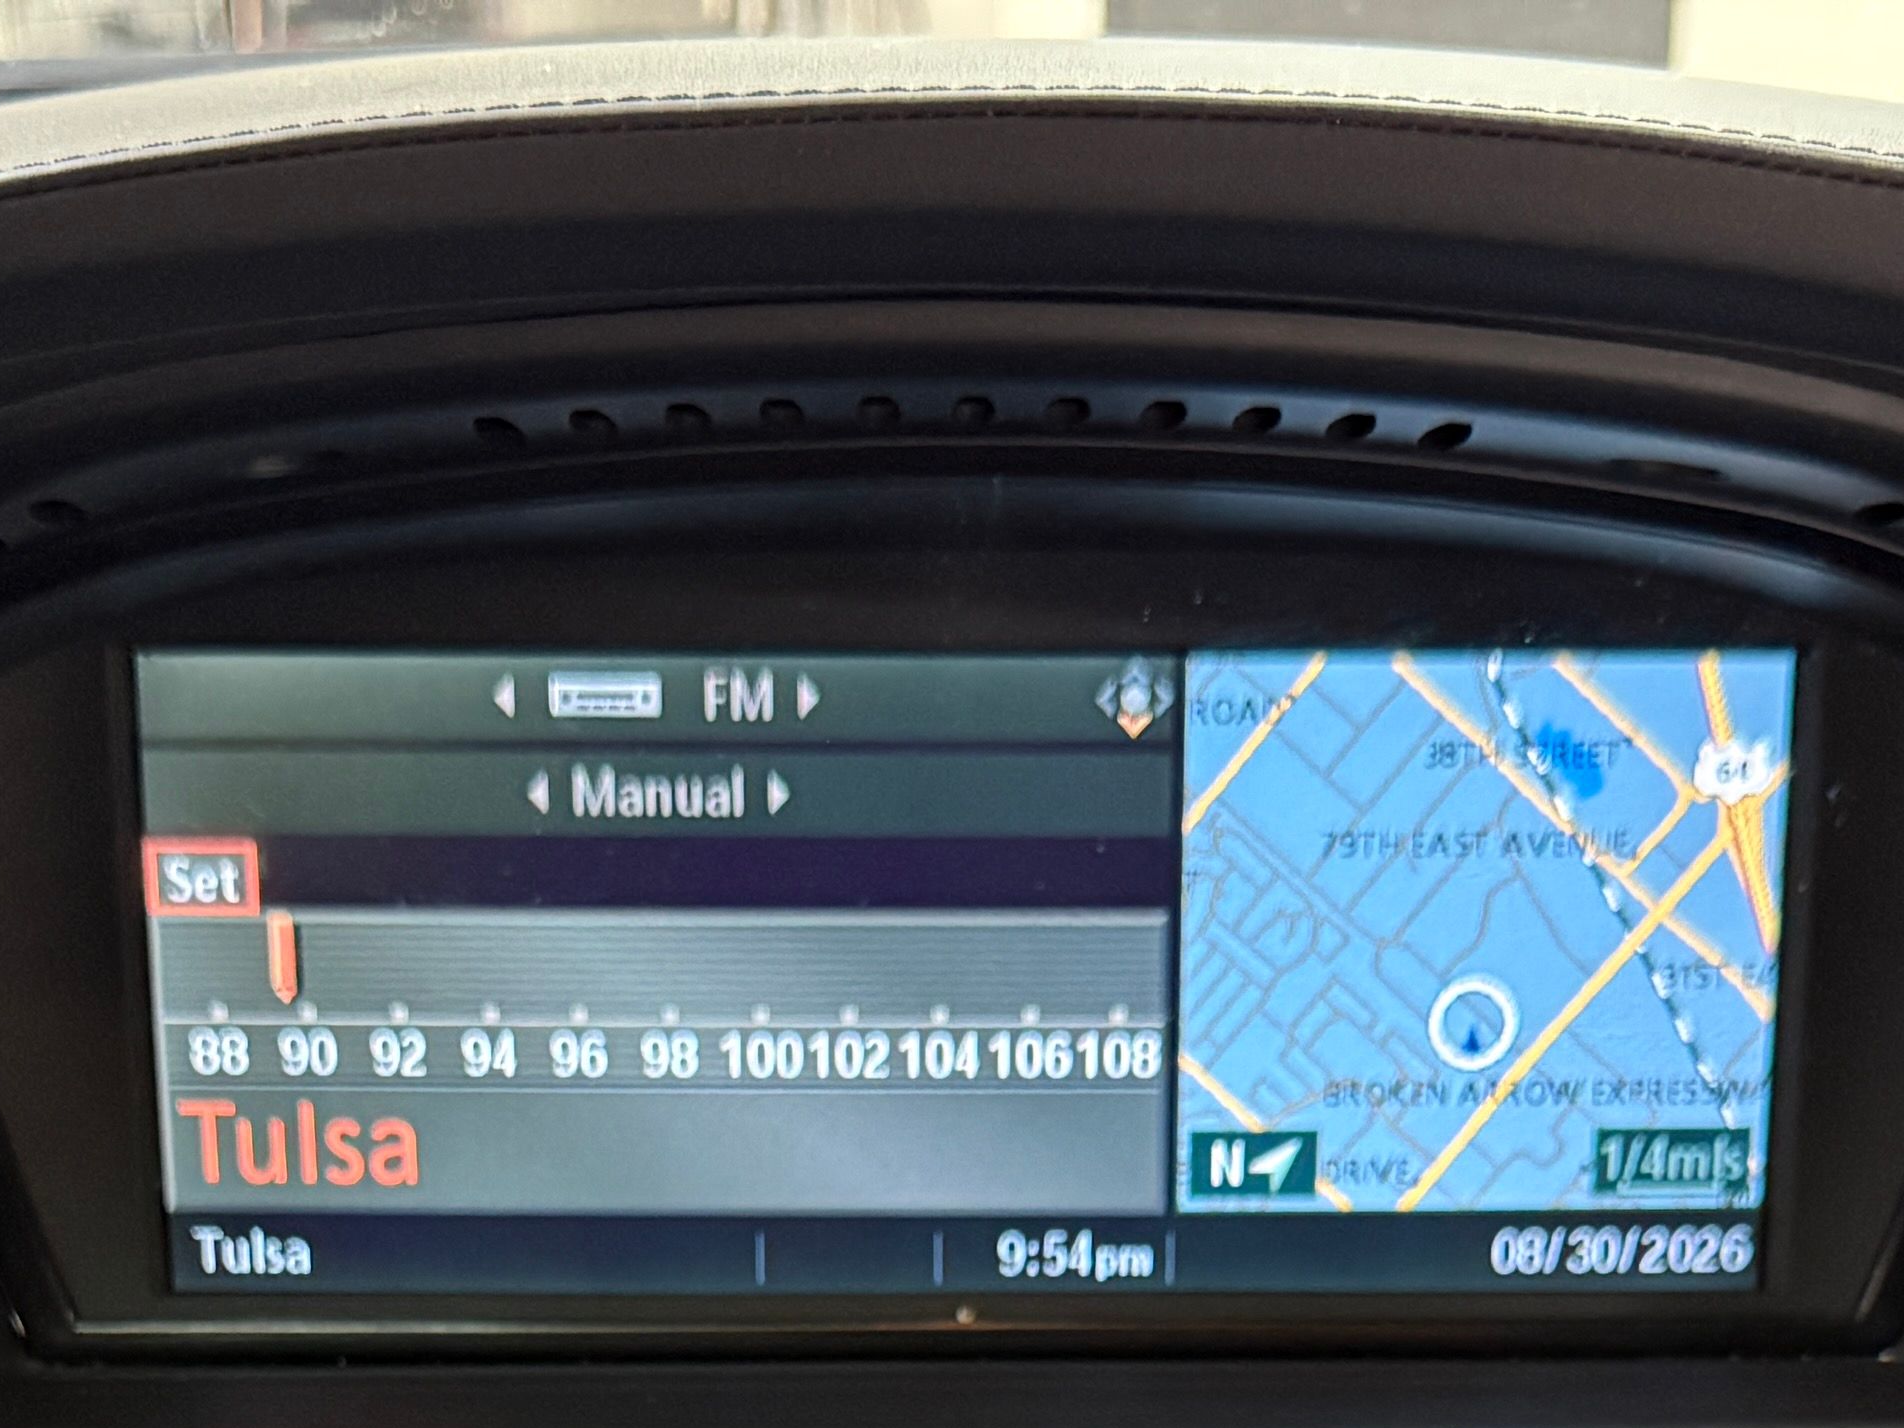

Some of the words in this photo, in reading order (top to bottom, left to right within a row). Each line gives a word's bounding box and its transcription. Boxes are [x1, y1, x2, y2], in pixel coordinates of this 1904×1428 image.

[704, 667, 774, 722] FM
[1190, 697, 1278, 727] ROA
[571, 763, 745, 818] Manual
[1411, 830, 1490, 859] EAST
[164, 856, 241, 904] Set
[189, 1027, 250, 1076] 88
[278, 1027, 338, 1077] 90
[369, 1028, 427, 1077] 92
[460, 1028, 518, 1078] 94
[549, 1029, 609, 1078] 96
[640, 1029, 700, 1079] 98
[720, 1030, 804, 1079] 100
[809, 1030, 890, 1080] 102
[899, 1030, 980, 1080] 104
[989, 1030, 1073, 1080] 106
[1077, 1030, 1162, 1080] 108
[175, 1099, 420, 1187] Tulsa
[1210, 1138, 1245, 1188] N
[190, 1226, 312, 1275] Tulsa
[997, 1228, 1154, 1282] 9:54pm
[1491, 1224, 1755, 1276] 08/30/2026
